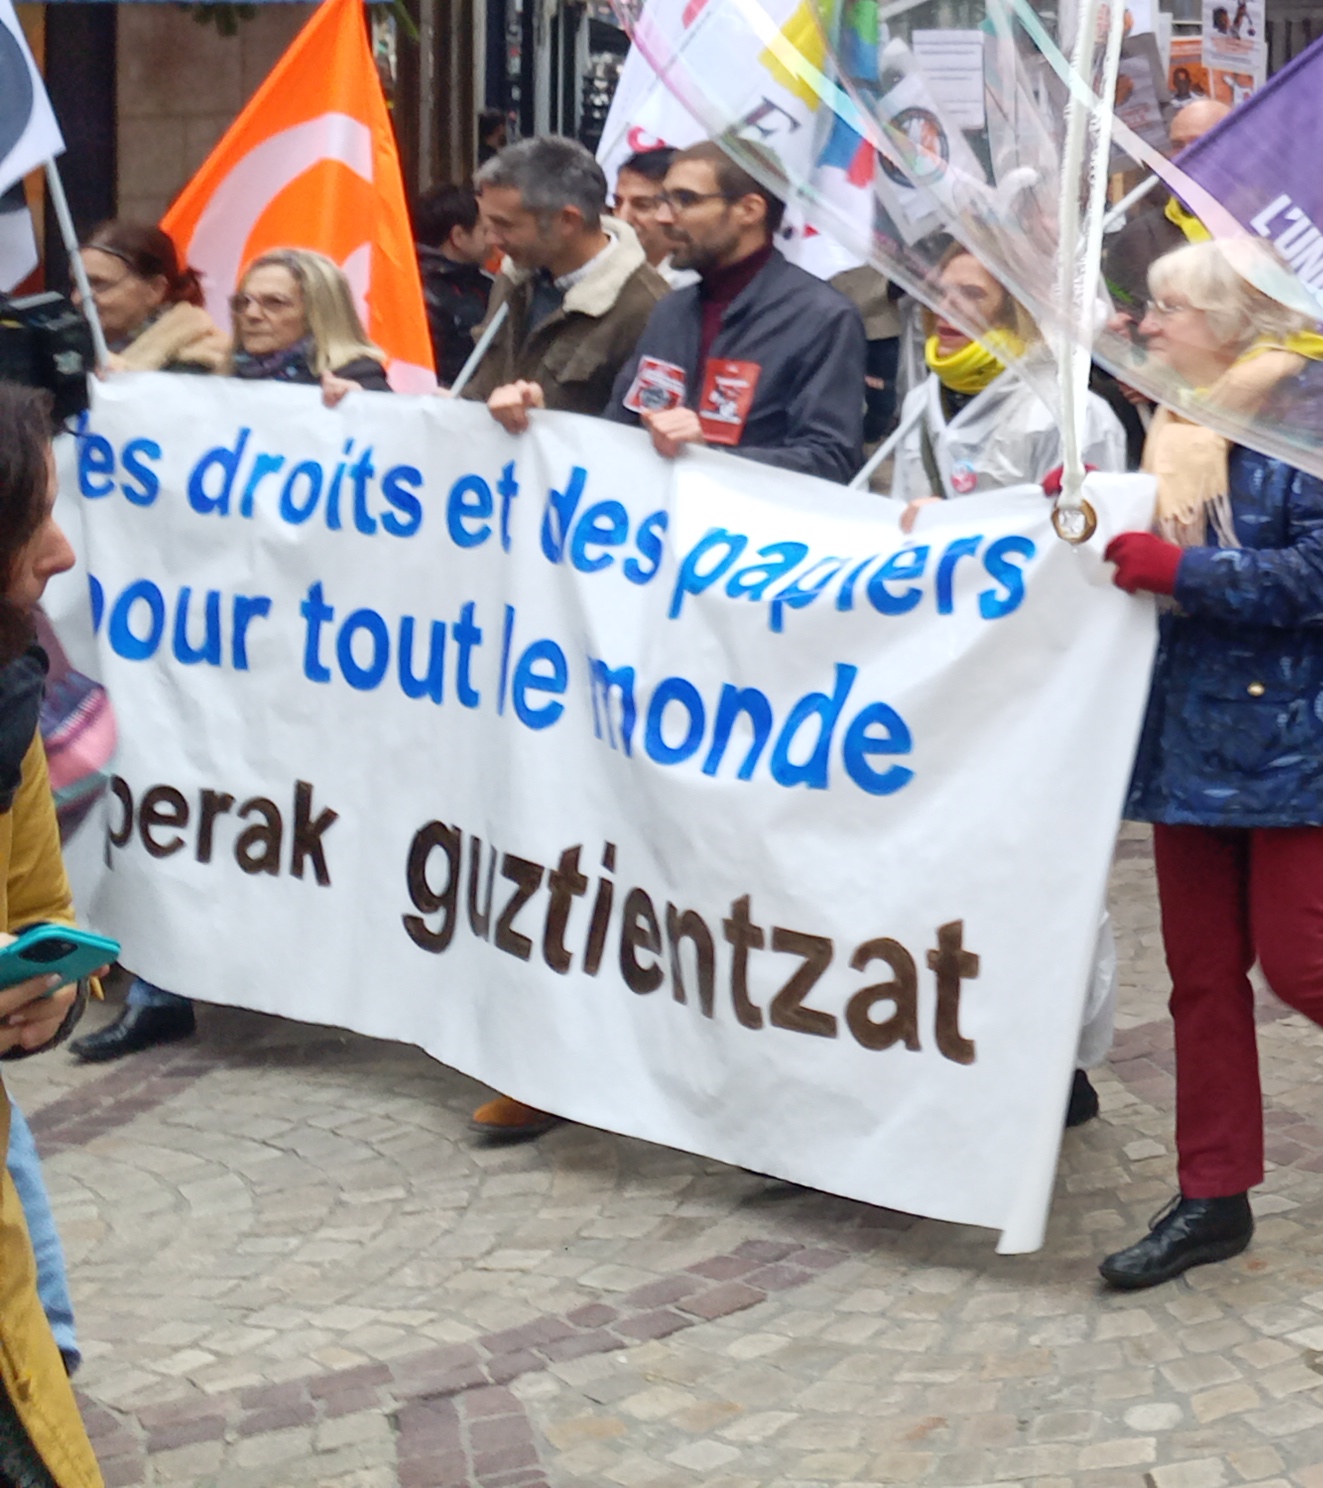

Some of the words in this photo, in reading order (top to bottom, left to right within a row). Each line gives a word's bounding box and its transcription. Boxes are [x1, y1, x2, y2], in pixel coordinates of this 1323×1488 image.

[187, 426, 423, 539] droits
[446, 460, 517, 552] et
[541, 464, 669, 586] des
[668, 526, 1037, 633] papiers
[300, 580, 482, 708] tout
[496, 605, 569, 730] le
[588, 655, 914, 796] monde
[405, 820, 981, 1066] guztientzat
